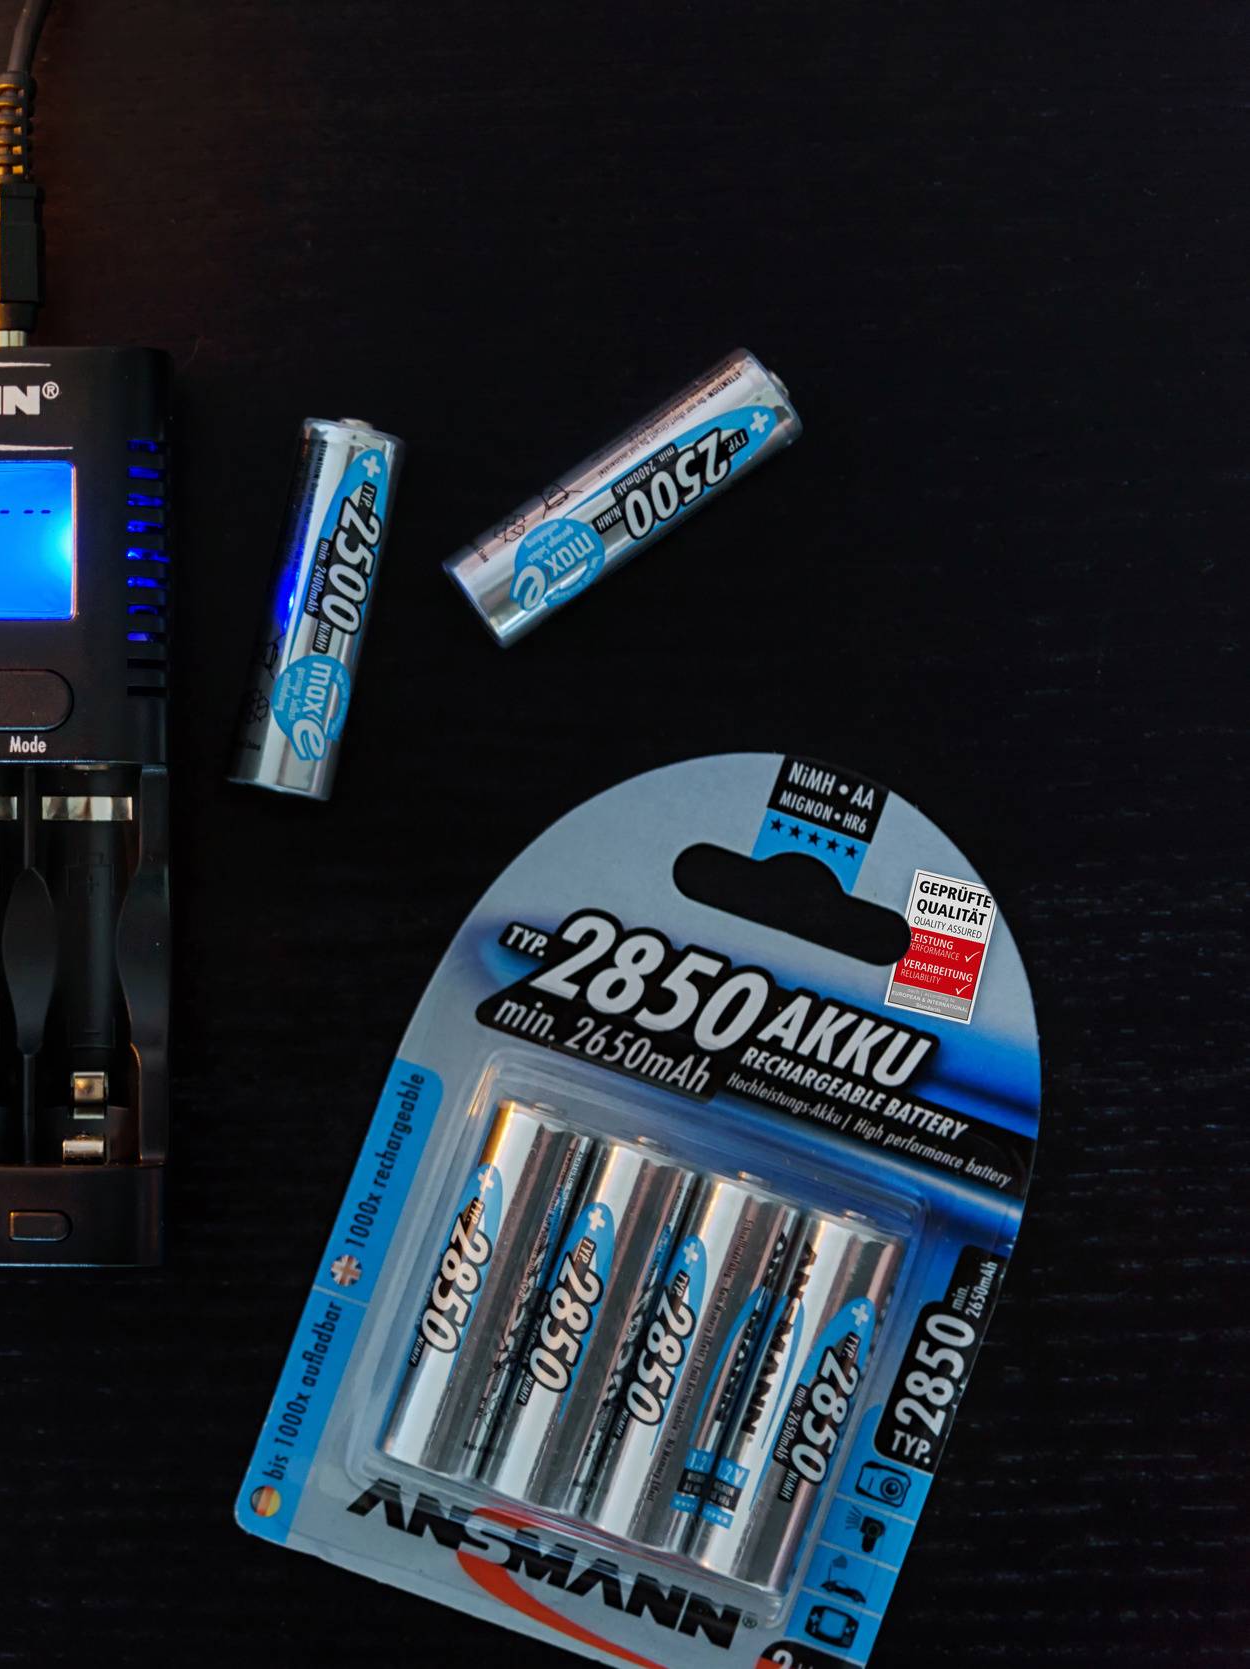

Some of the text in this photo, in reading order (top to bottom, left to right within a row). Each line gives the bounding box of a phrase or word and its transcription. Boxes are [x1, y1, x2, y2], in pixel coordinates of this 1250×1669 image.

[725, 431, 746, 452] TYP.
[614, 446, 675, 496] min. 2400mAh
[625, 431, 728, 539] 2500
[360, 484, 376, 508] TYP.
[596, 505, 622, 531] NiMH
[316, 541, 330, 564] min.
[321, 499, 381, 632] 2500
[544, 532, 595, 576] max
[306, 567, 327, 612] 2400mAh
[314, 619, 332, 652] NiMH
[302, 662, 332, 715] max
[9, 736, 47, 754] Mode
[788, 761, 875, 811] NiMH AA
[916, 898, 988, 926] QUALITÄT
[919, 880, 992, 908] GEPRÜFTE
[505, 925, 548, 956] TYP.
[913, 915, 983, 939] QUALITY ASSURED
[900, 968, 942, 985] RELIABILITY
[903, 958, 973, 983] VERARBEITUNG
[529, 915, 931, 1088] 2850 AKKU
[494, 998, 712, 1093] min. 2650mAh
[740, 1047, 969, 1141] RECHARGEABLE BATTERY
[726, 1072, 842, 1124] Hochleistungs-Akku
[853, 1117, 884, 1141] High
[883, 1131, 964, 1169] performance
[964, 1159, 1013, 1188] battery
[345, 1072, 426, 1248] 1000x rechargeable
[465, 1199, 485, 1225] TYP.
[577, 1238, 595, 1264] TYP.
[422, 1216, 489, 1352] 2850
[674, 1270, 690, 1297] TYP.
[952, 1259, 998, 1320] min. 2650mAh
[529, 1255, 601, 1391] 2850
[627, 1293, 694, 1424] 2850
[842, 1333, 860, 1360] TYP.
[263, 1300, 344, 1481] bis 1000x aufladbar
[519, 1373, 534, 1404] NiMH
[891, 1312, 976, 1464] TYP. 2850
[773, 1386, 807, 1461] min. 2650mAh
[791, 1349, 859, 1484] 2850
[779, 1468, 799, 1500] NiMH
